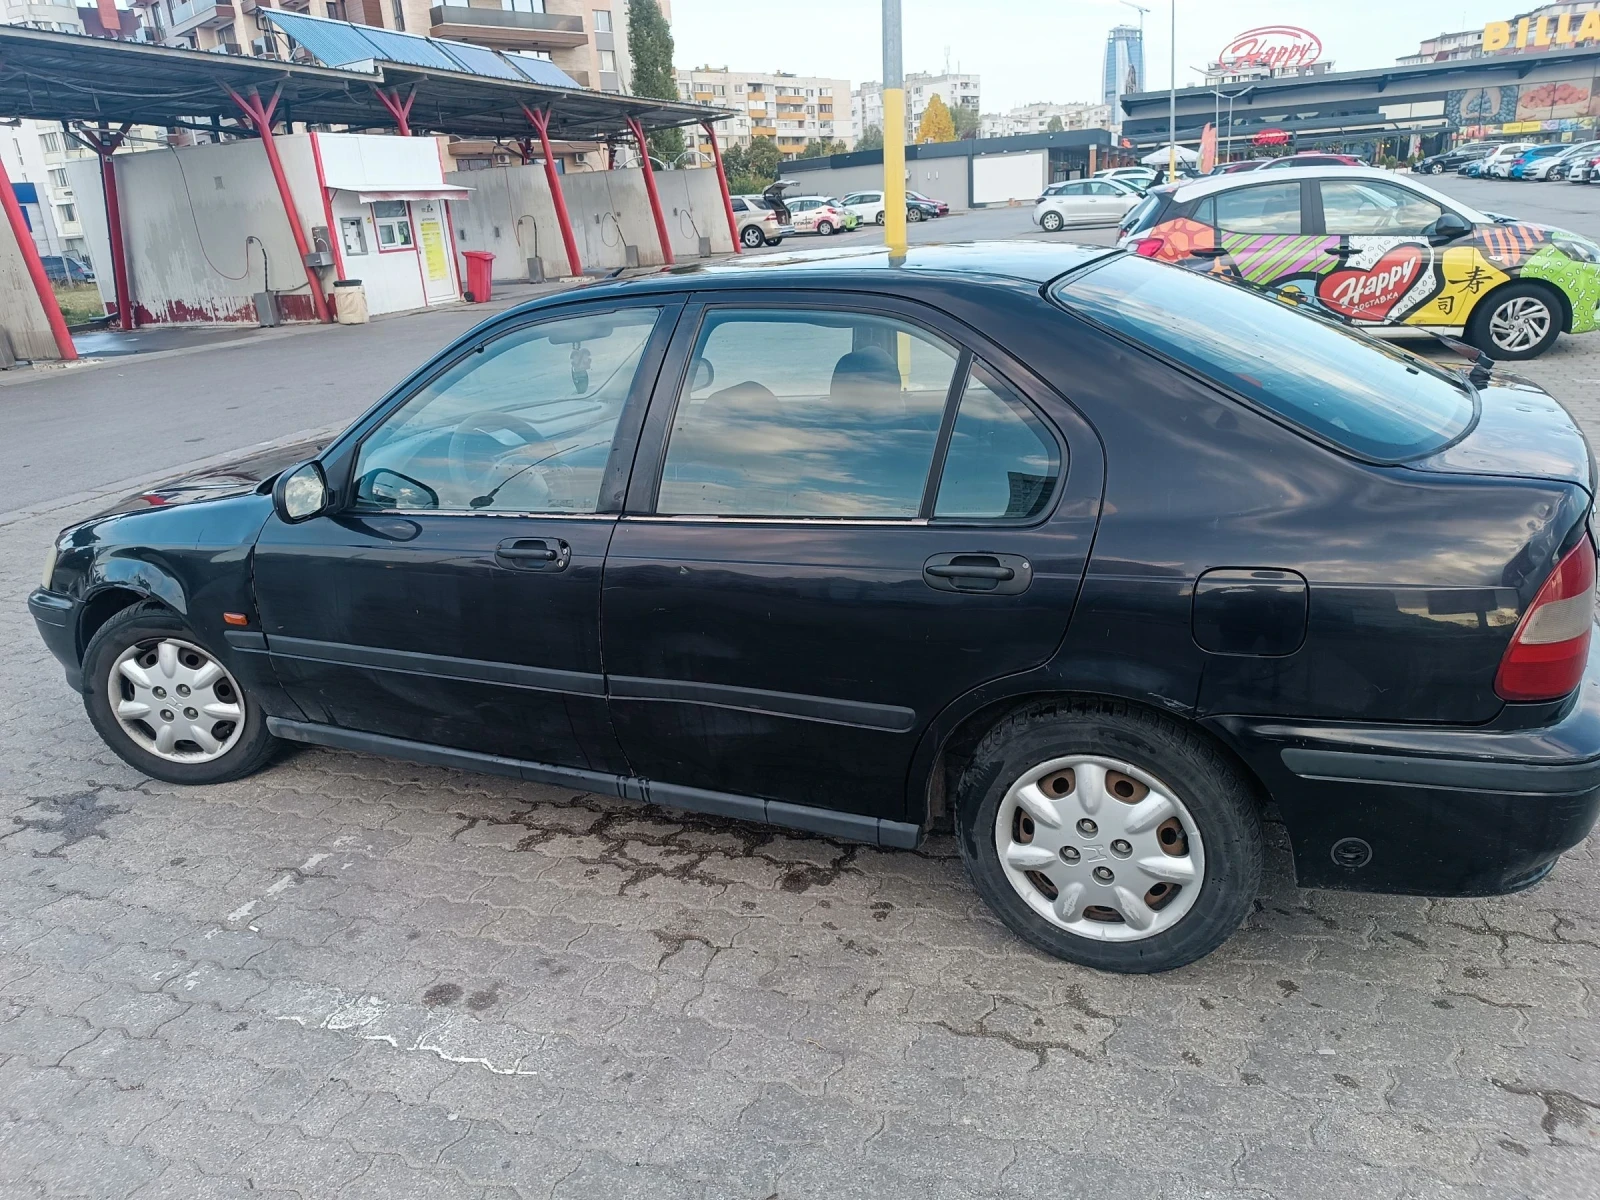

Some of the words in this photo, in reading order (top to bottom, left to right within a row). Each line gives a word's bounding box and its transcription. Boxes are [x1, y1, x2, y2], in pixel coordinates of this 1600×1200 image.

[1482, 10, 1600, 51] BILLA
[1231, 38, 1313, 69] Happy
[1332, 256, 1417, 308] Happy
